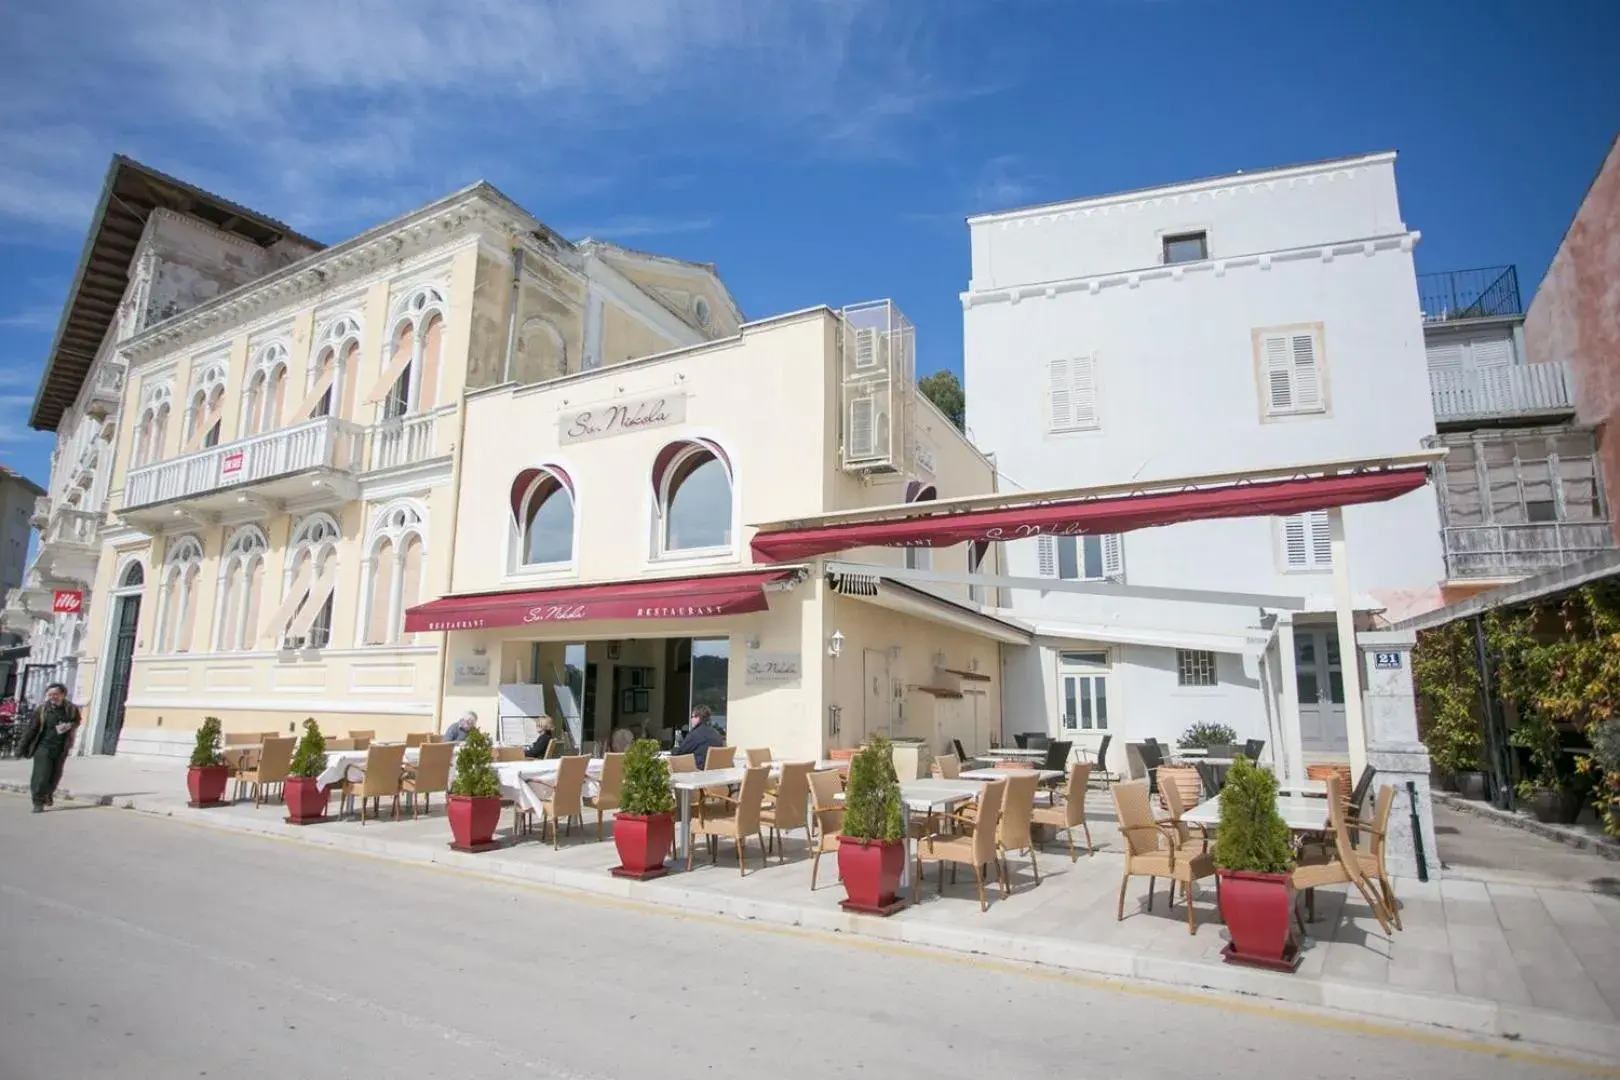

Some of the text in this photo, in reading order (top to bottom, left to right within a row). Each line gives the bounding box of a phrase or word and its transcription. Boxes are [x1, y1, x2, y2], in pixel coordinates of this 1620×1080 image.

[55, 593, 80, 611] illy
[429, 618, 484, 630] RESTAURANT
[636, 605, 723, 617] RESTAURANT
[1378, 653, 1397, 663] 21
